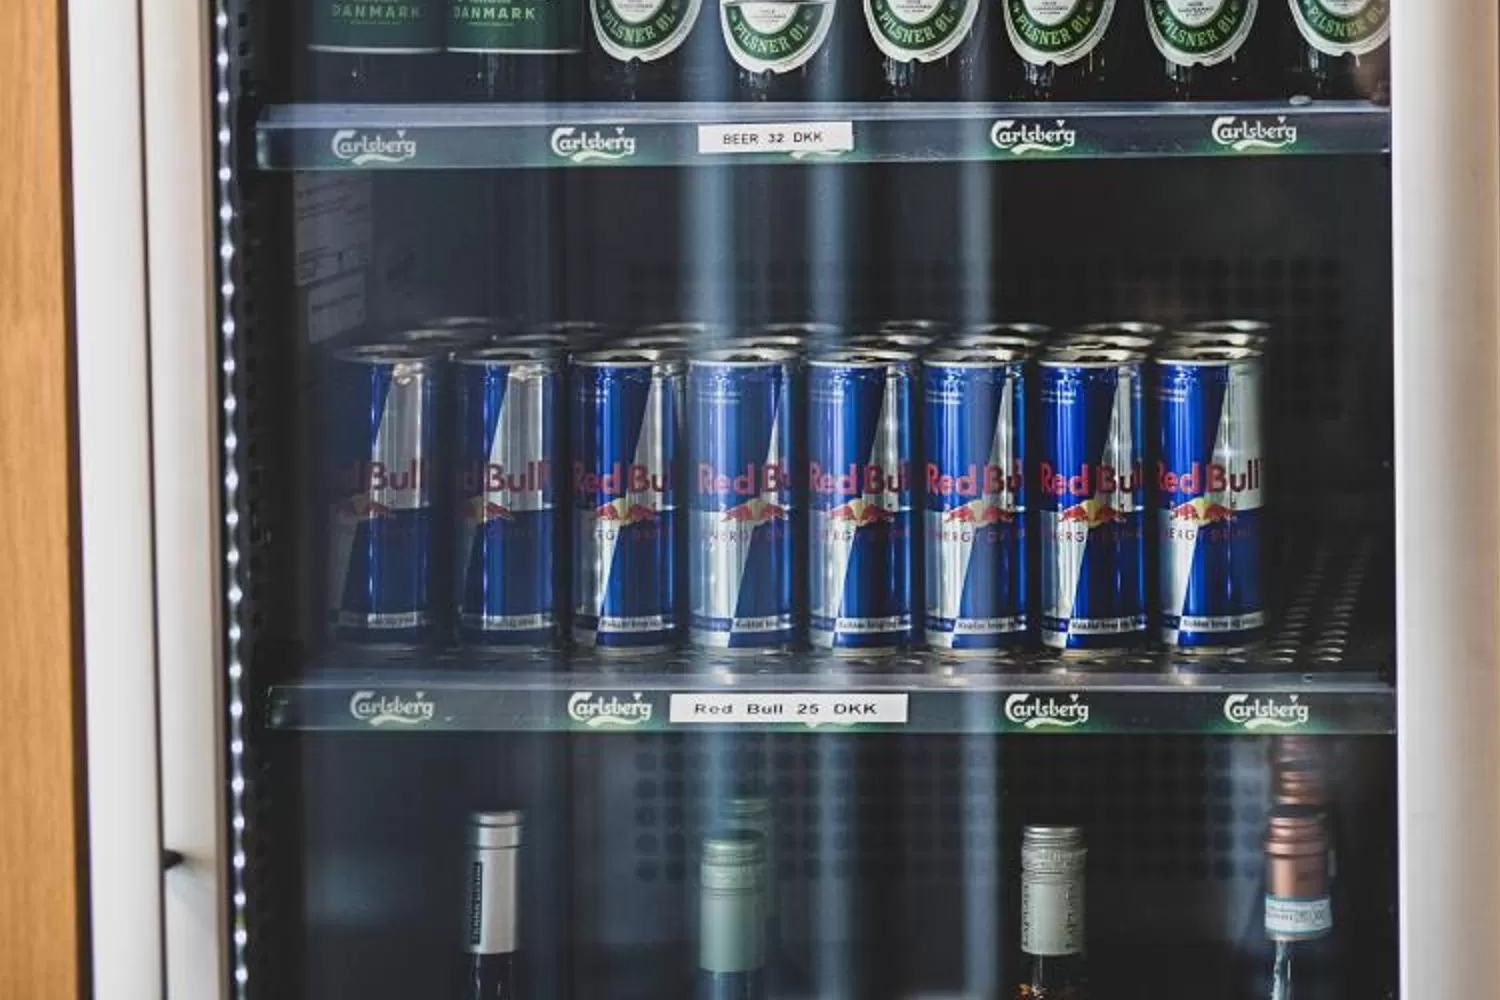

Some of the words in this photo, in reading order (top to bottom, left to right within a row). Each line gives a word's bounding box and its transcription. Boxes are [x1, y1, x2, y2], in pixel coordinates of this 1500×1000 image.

[332, 3, 420, 18] DANMARK
[453, 6, 536, 20] DANMARK
[331, 128, 416, 164] Carlsberg
[551, 126, 636, 161] Carlsberg
[723, 133, 759, 146] BEER
[768, 132, 785, 144] 32
[793, 131, 824, 144] DKK
[991, 119, 1076, 153] Carlsberg
[1211, 116, 1297, 150] Carlsberg
[573, 461, 621, 494] Red
[628, 463, 672, 493] Bu
[697, 463, 755, 496] Red
[808, 461, 857, 496] Red
[926, 463, 977, 497] Red
[1040, 461, 1089, 497] Red
[1205, 459, 1260, 493] Bull
[350, 691, 435, 725] Carlsberg
[567, 690, 653, 724] Carlsberg
[694, 702, 733, 716] Red
[747, 701, 785, 716] Bull
[797, 702, 820, 715] 25
[833, 702, 878, 715] DKK
[1004, 693, 1089, 728] Carlsberg
[1223, 693, 1309, 728] Carlsberg
